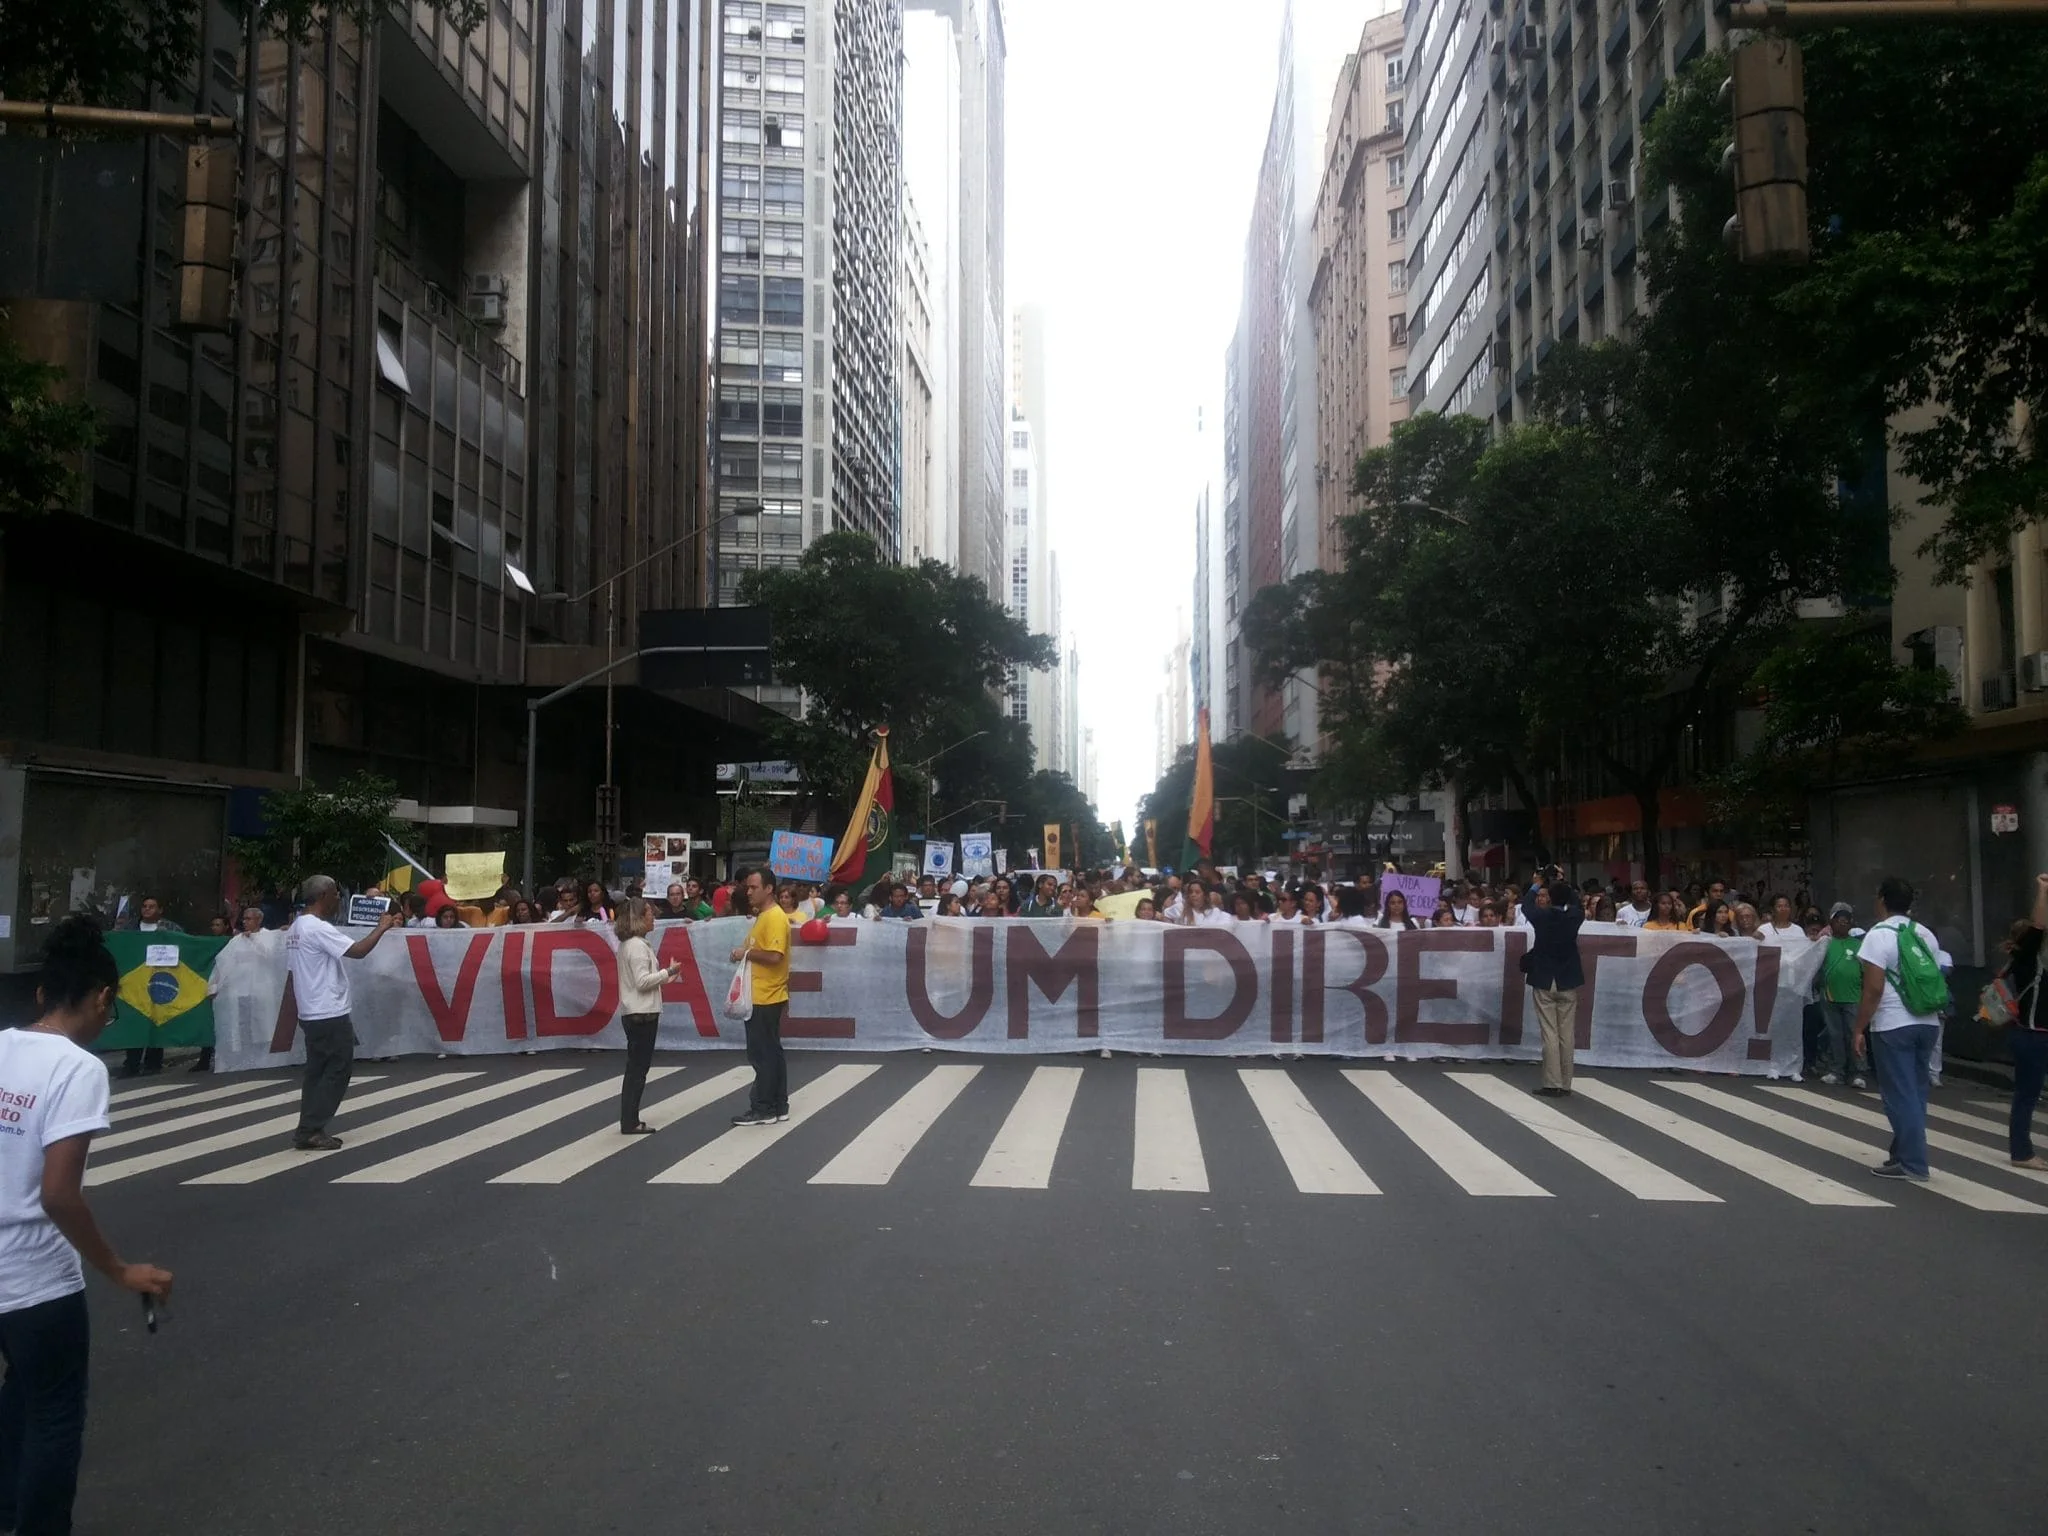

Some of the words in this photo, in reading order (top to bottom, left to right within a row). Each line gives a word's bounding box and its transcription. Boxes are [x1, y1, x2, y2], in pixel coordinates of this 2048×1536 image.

[405, 926, 720, 1042] VIDA
[906, 926, 1099, 1039] UM
[1163, 928, 1781, 1061] DIREITO!
